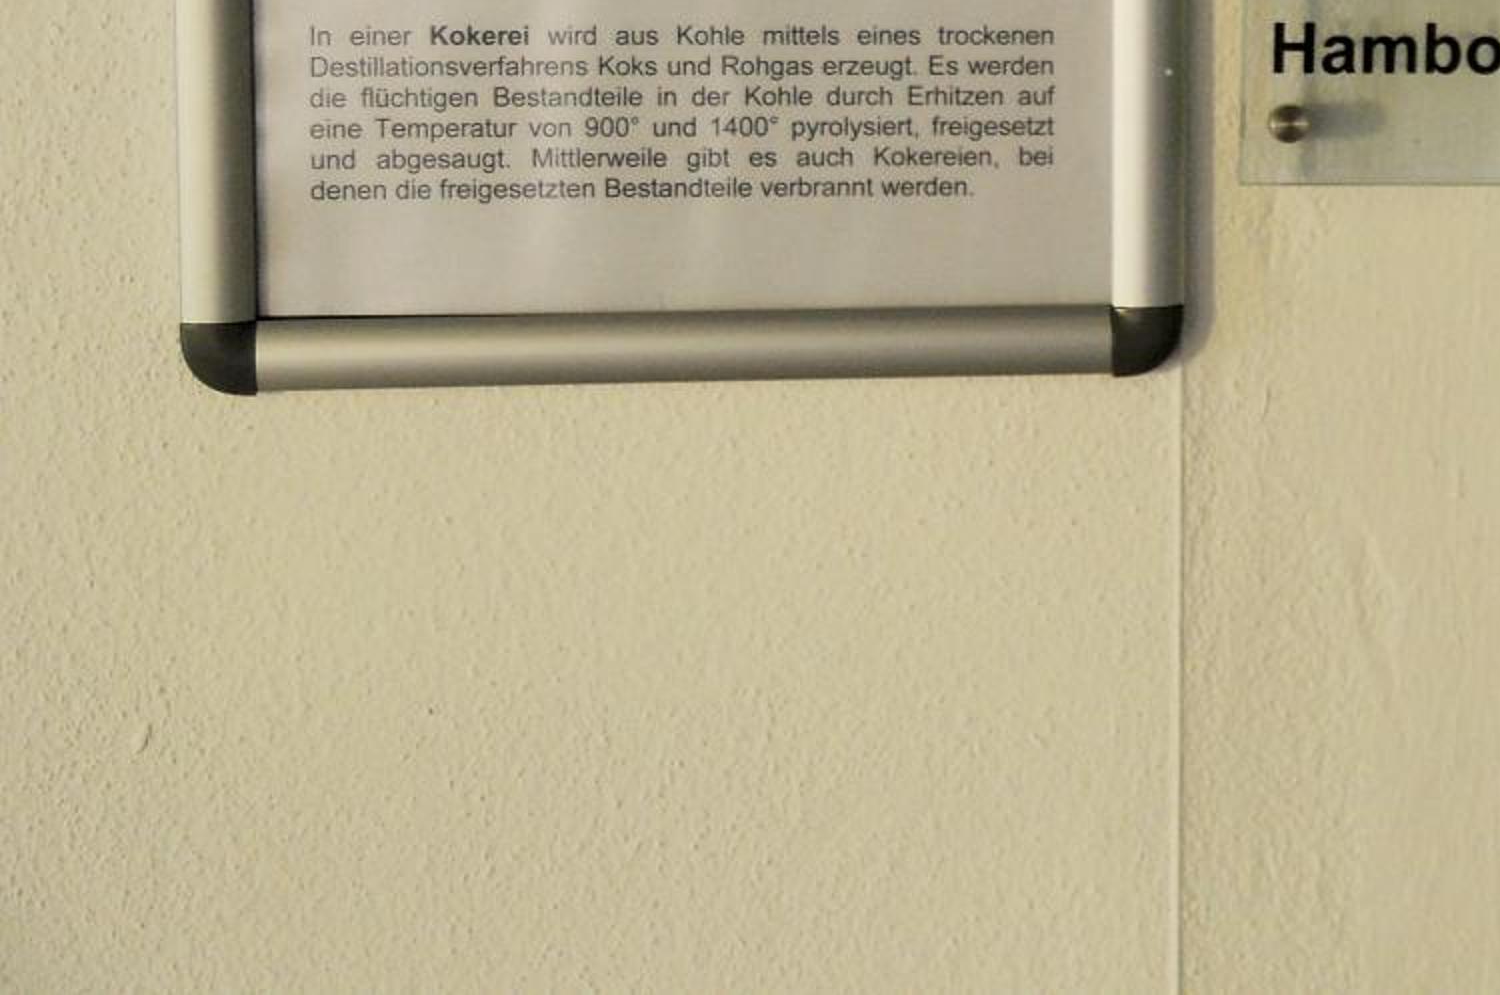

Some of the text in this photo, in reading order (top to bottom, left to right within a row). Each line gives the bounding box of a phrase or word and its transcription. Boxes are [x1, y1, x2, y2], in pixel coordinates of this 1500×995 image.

[309, 25, 1054, 46] In einer Kokerei wird aus Kohle mittels eines trockenen
[311, 55, 1054, 81] Destillationsverfahrens Koks und Rohgas erzeugt. Es werden
[310, 85, 1055, 112] die flüchtigen Bestandteile in der Kohle durch Erhitzen auf
[310, 115, 1054, 143] eine Temperatur von 900° und 1400° pyrolysiert, freigesetzt
[311, 146, 1054, 173] und abgesaugt. Mittlerweile gibt es auch Kokereien, bei
[311, 176, 974, 203] denen die freigesetzten Bestandteile verbrannt werden.
